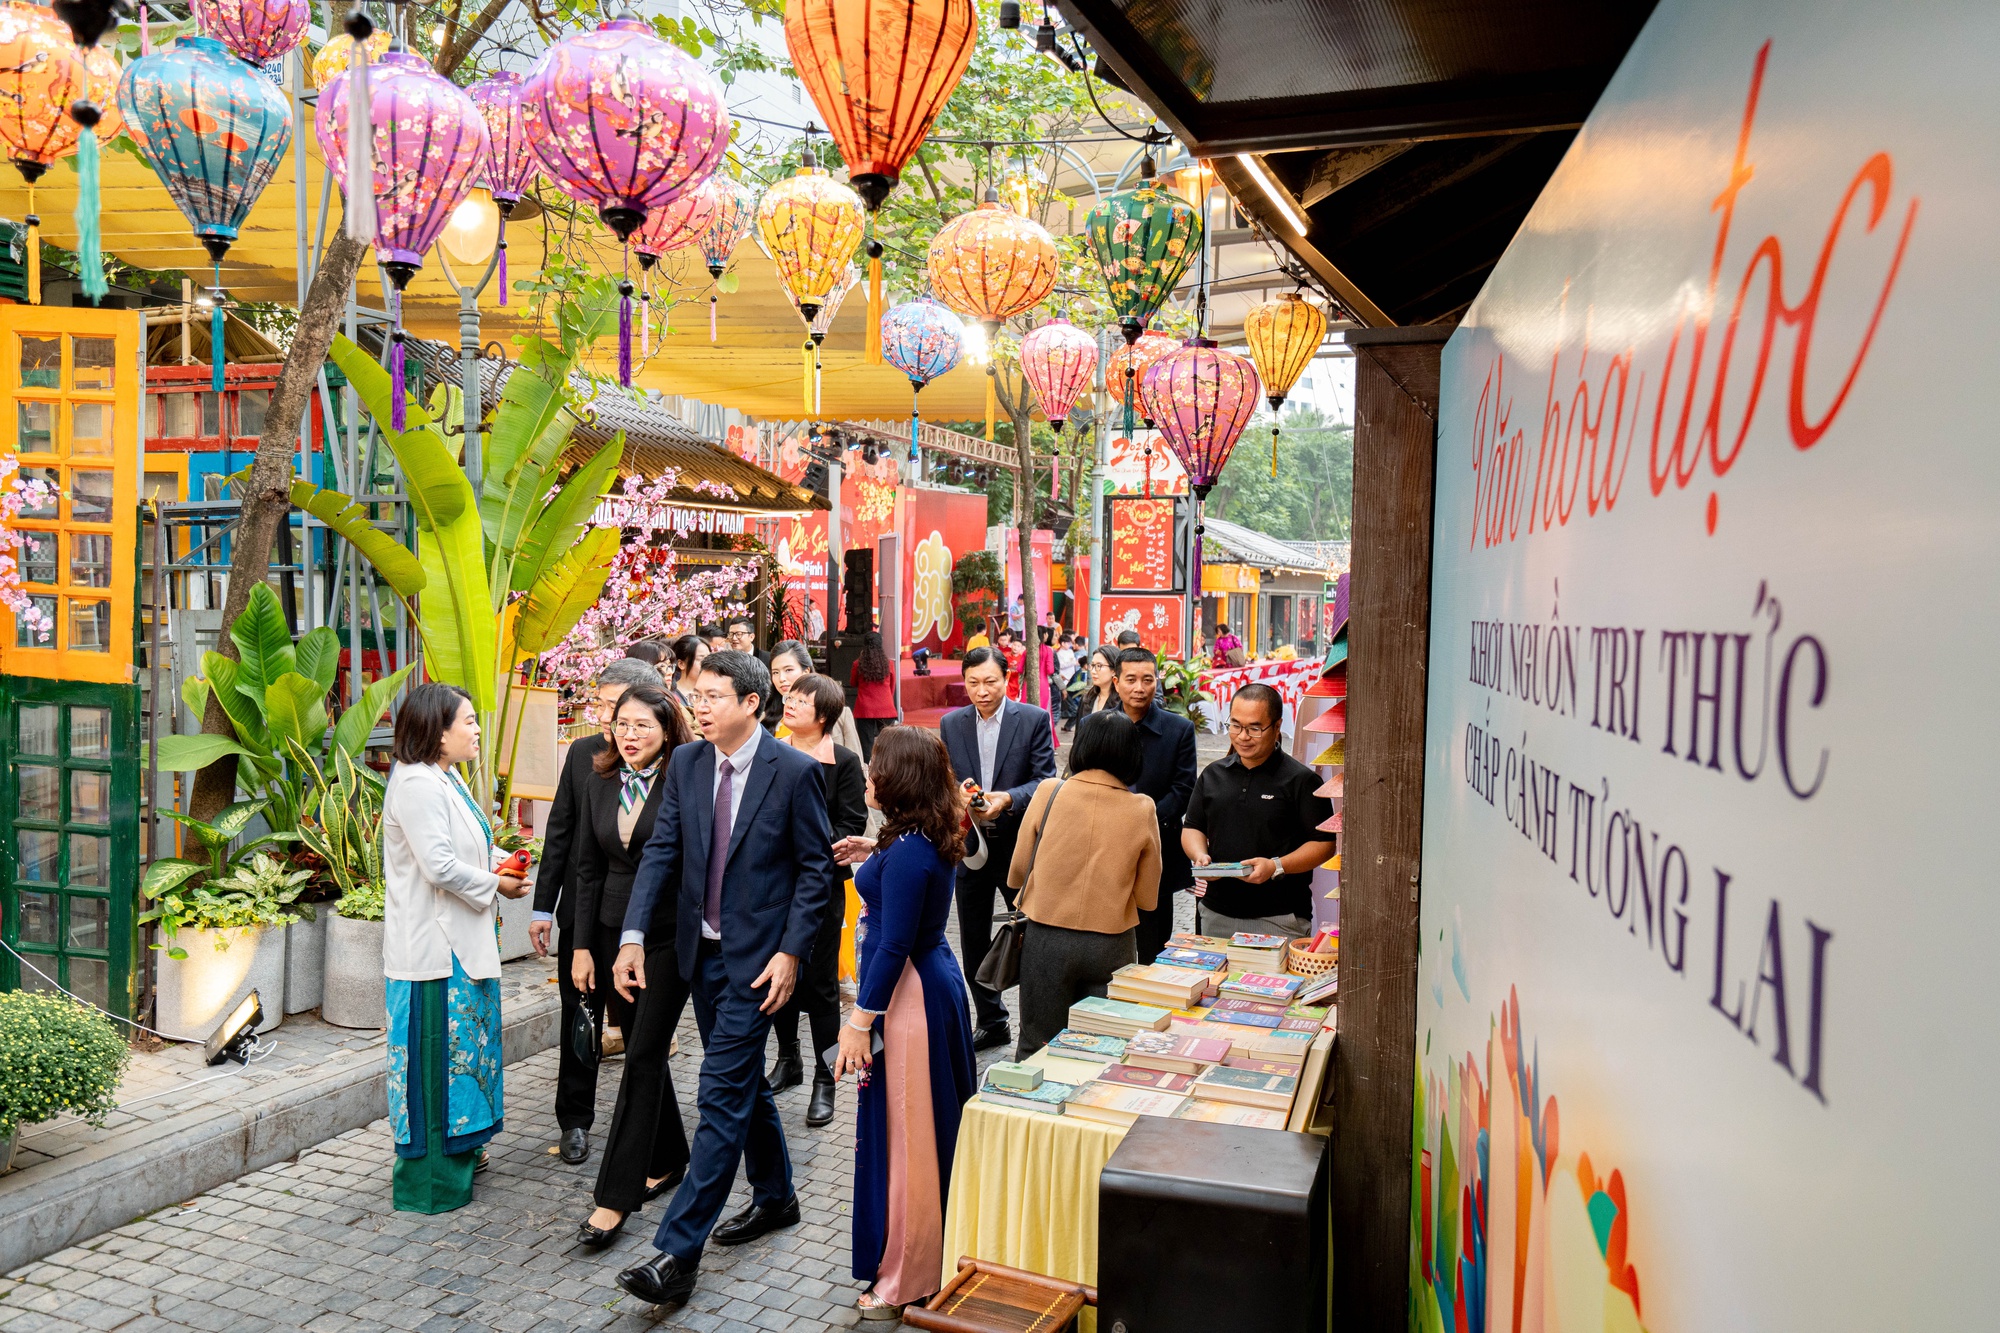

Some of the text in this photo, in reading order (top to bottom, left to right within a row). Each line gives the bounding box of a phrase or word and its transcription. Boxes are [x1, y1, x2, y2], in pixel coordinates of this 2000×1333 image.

[1470, 36, 1921, 553] Văn hóa đọc
[716, 512, 745, 538] PHẠM
[810, 524, 829, 556] Sác
[1507, 576, 1581, 720] NGUỒN
[1589, 626, 1646, 744] TRI
[1659, 578, 1830, 801] THỨC
[1465, 696, 1834, 1108] CHẮP CÁNH TƯƠNG LAI
